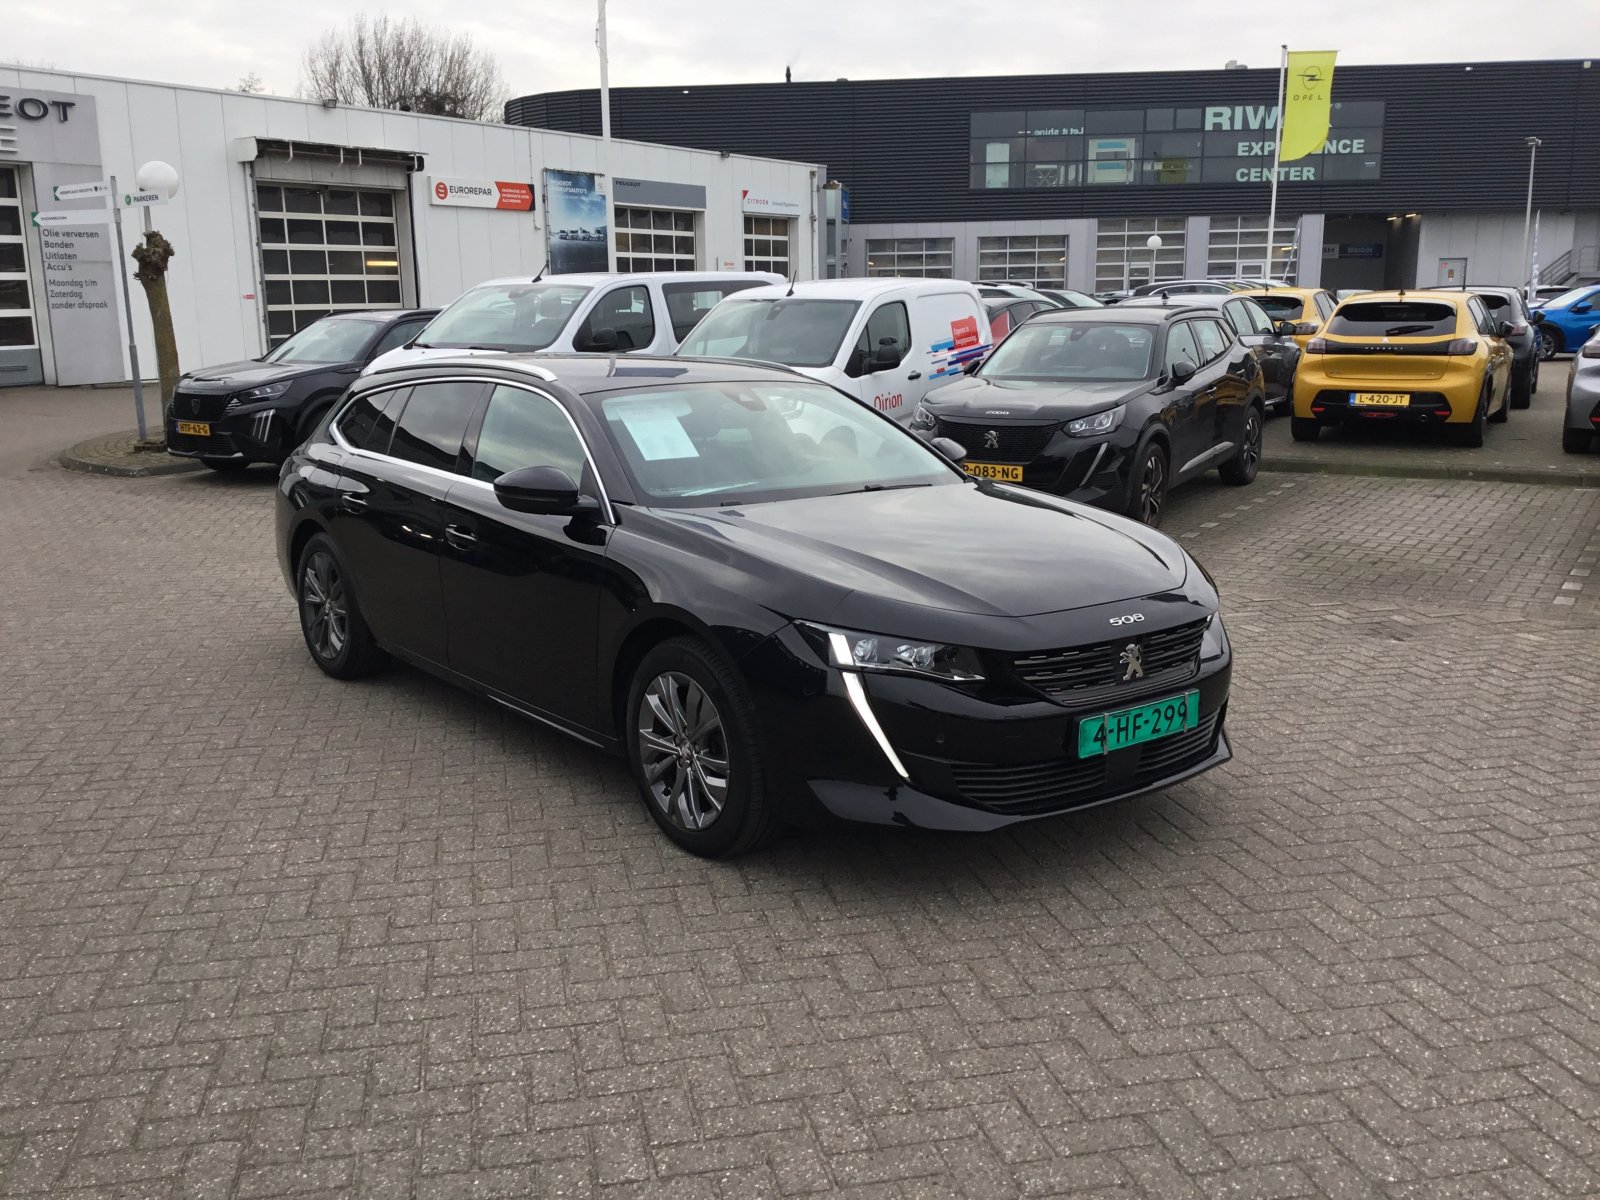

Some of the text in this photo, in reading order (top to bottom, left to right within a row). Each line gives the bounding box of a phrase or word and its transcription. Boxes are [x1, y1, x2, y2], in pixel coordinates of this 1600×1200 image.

[1235, 167, 1316, 182] CENTER
[449, 185, 492, 197] EUROREPAR
[133, 194, 159, 202] PARKEREN
[42, 229, 60, 237] Olie
[45, 252, 77, 260] Uitlaten
[47, 263, 73, 271] Accu's
[49, 279, 83, 288] Maandag
[50, 290, 83, 299] Zaterdag
[77, 301, 108, 309] afspraak
[1359, 394, 1405, 404] L-420-JT
[1109, 613, 1145, 626] 508
[1092, 702, 1187, 748] 4-HF-299
